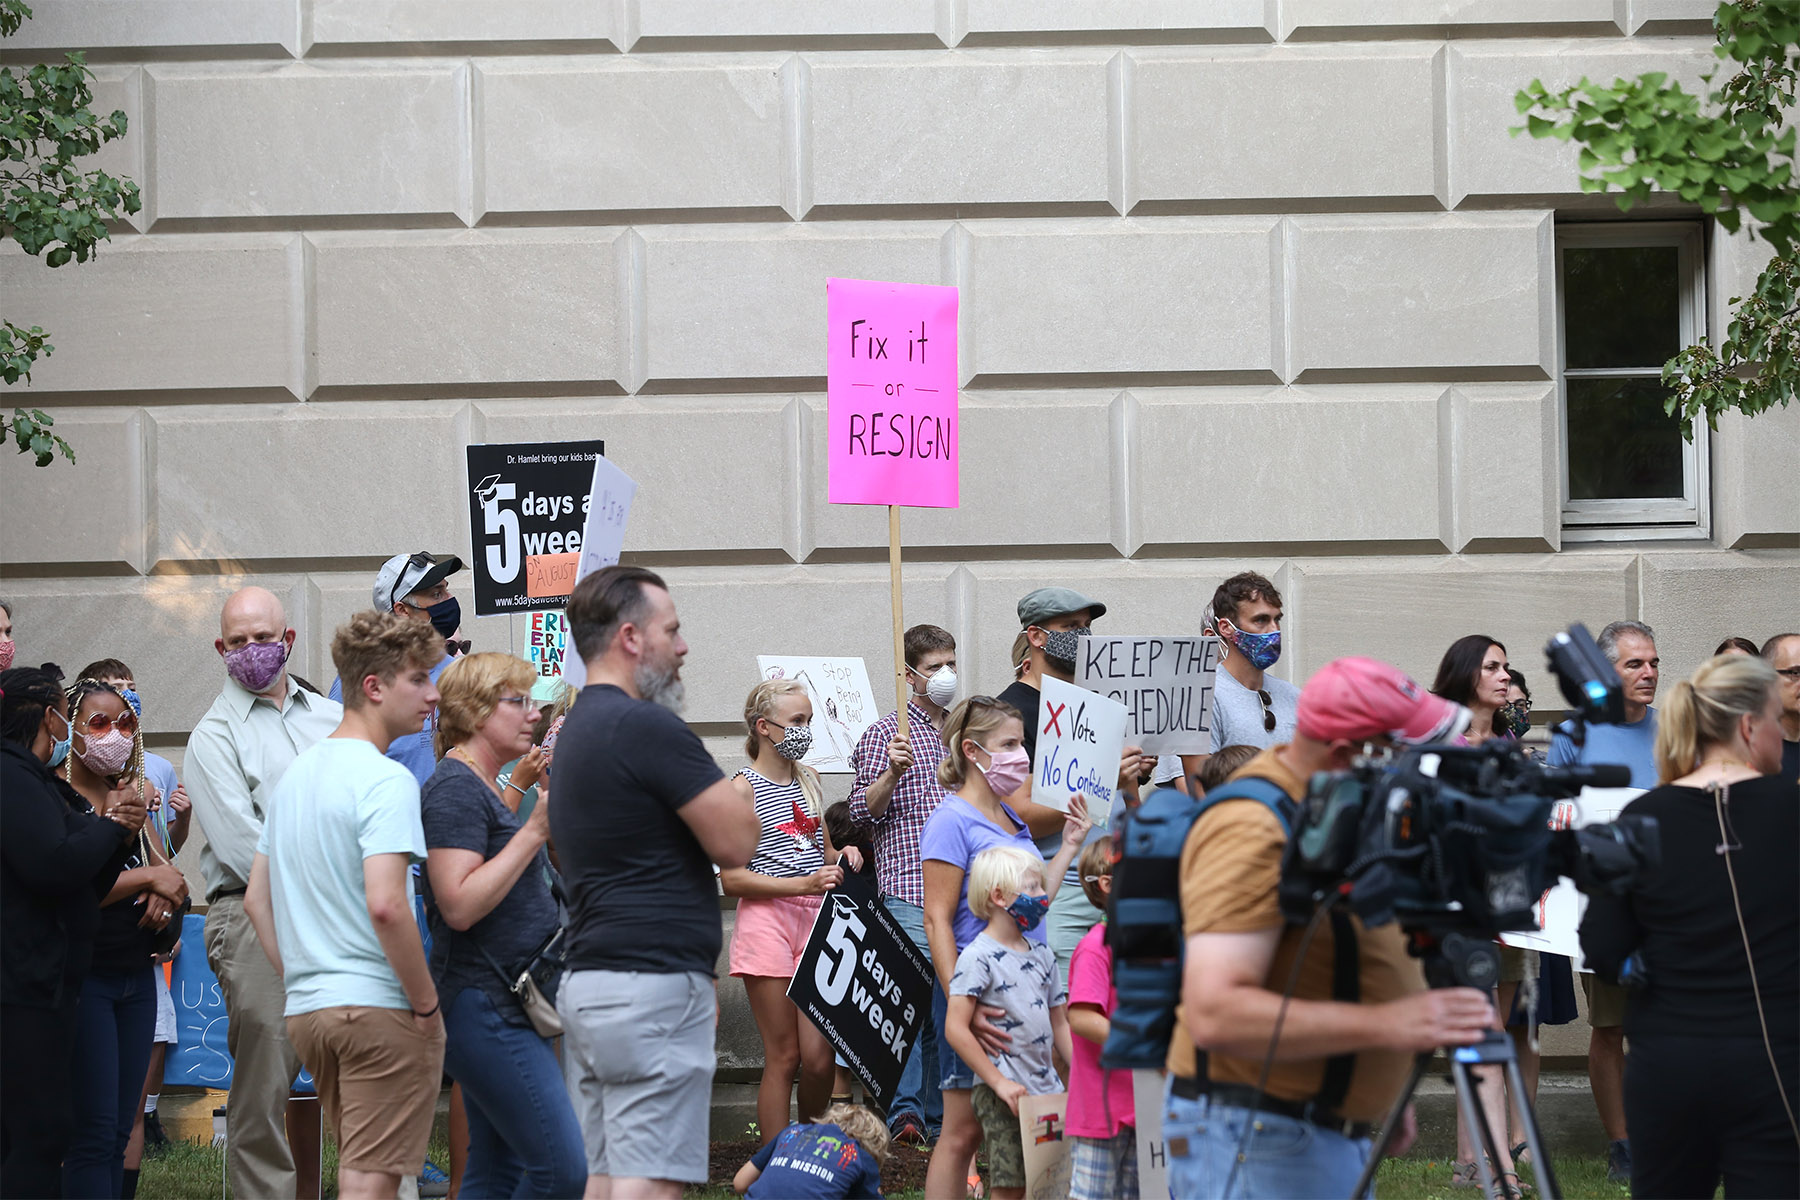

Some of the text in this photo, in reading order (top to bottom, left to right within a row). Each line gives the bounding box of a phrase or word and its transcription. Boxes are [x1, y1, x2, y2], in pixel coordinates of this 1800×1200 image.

[851, 319, 929, 364] Fix it
[885, 383, 905, 397] or
[849, 412, 951, 461] RESIGN
[507, 455, 517, 464] Dr.
[518, 454, 541, 464] Hamlet
[541, 453, 558, 465] bring
[558, 454, 570, 463] our
[570, 452, 584, 462] kids
[484, 483, 521, 584] 5
[521, 492, 574, 521] days
[523, 522, 586, 556] wee
[527, 557, 541, 576] ON
[535, 562, 576, 590] AUGUST
[531, 646, 565, 663] PLAY
[823, 663, 852, 687] Stop
[1085, 639, 1219, 680] KEEP THE
[836, 685, 863, 711] Being
[1090, 686, 1213, 738] HEDULE
[1069, 701, 1097, 744] Vote
[1041, 745, 1112, 802] No Confidence
[867, 899, 933, 988] Dr. Hamlet bring our kids back
[815, 909, 916, 1027] 5 days a
[851, 976, 908, 1064] week
[807, 1001, 882, 1097] www.5daysaweek-pps.org
[770, 1156, 789, 1167] ONE
[790, 1158, 834, 1183] MISSION
